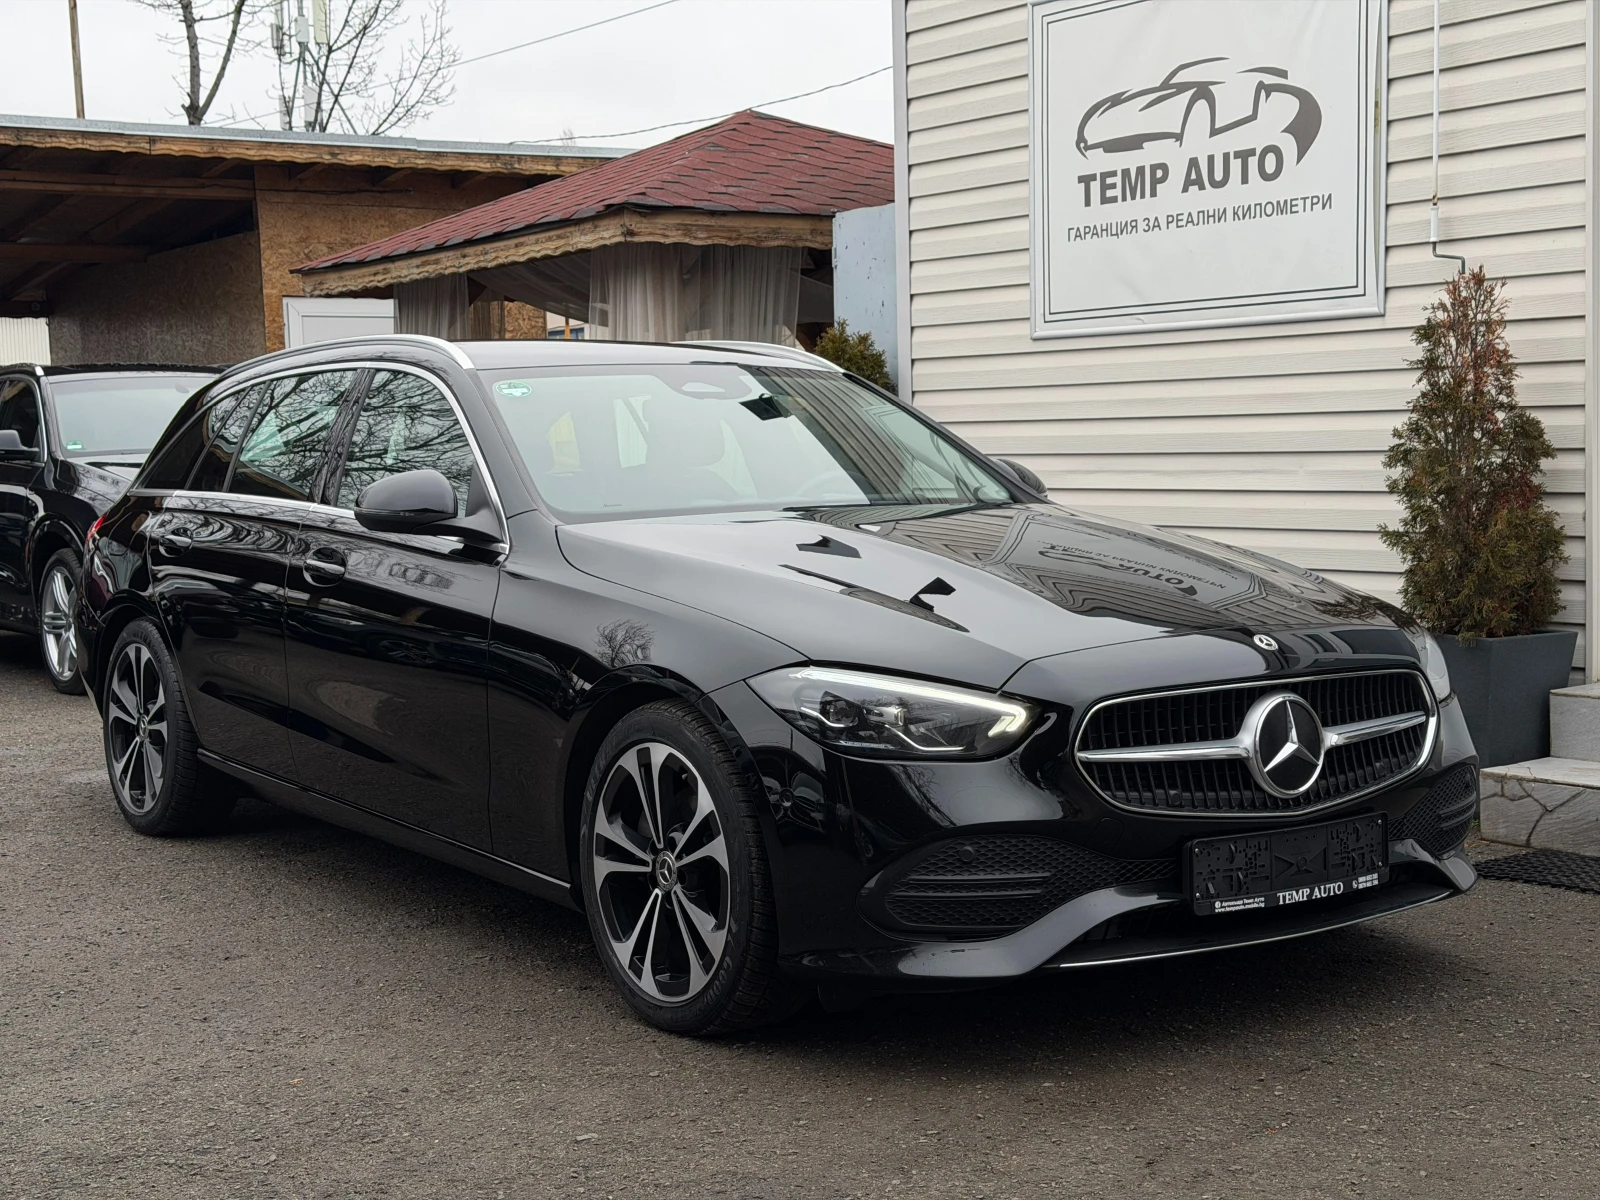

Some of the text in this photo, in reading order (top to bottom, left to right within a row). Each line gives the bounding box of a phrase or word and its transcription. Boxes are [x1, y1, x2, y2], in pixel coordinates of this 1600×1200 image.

[1077, 144, 1284, 208] TEMP AUTO
[1067, 193, 1333, 242] ГАРАНЦИЯ ЗА РЕАЛНИ КИЛОМЕТРИ
[1277, 889, 1310, 905] TEMP
[1312, 881, 1344, 899] AUTO
